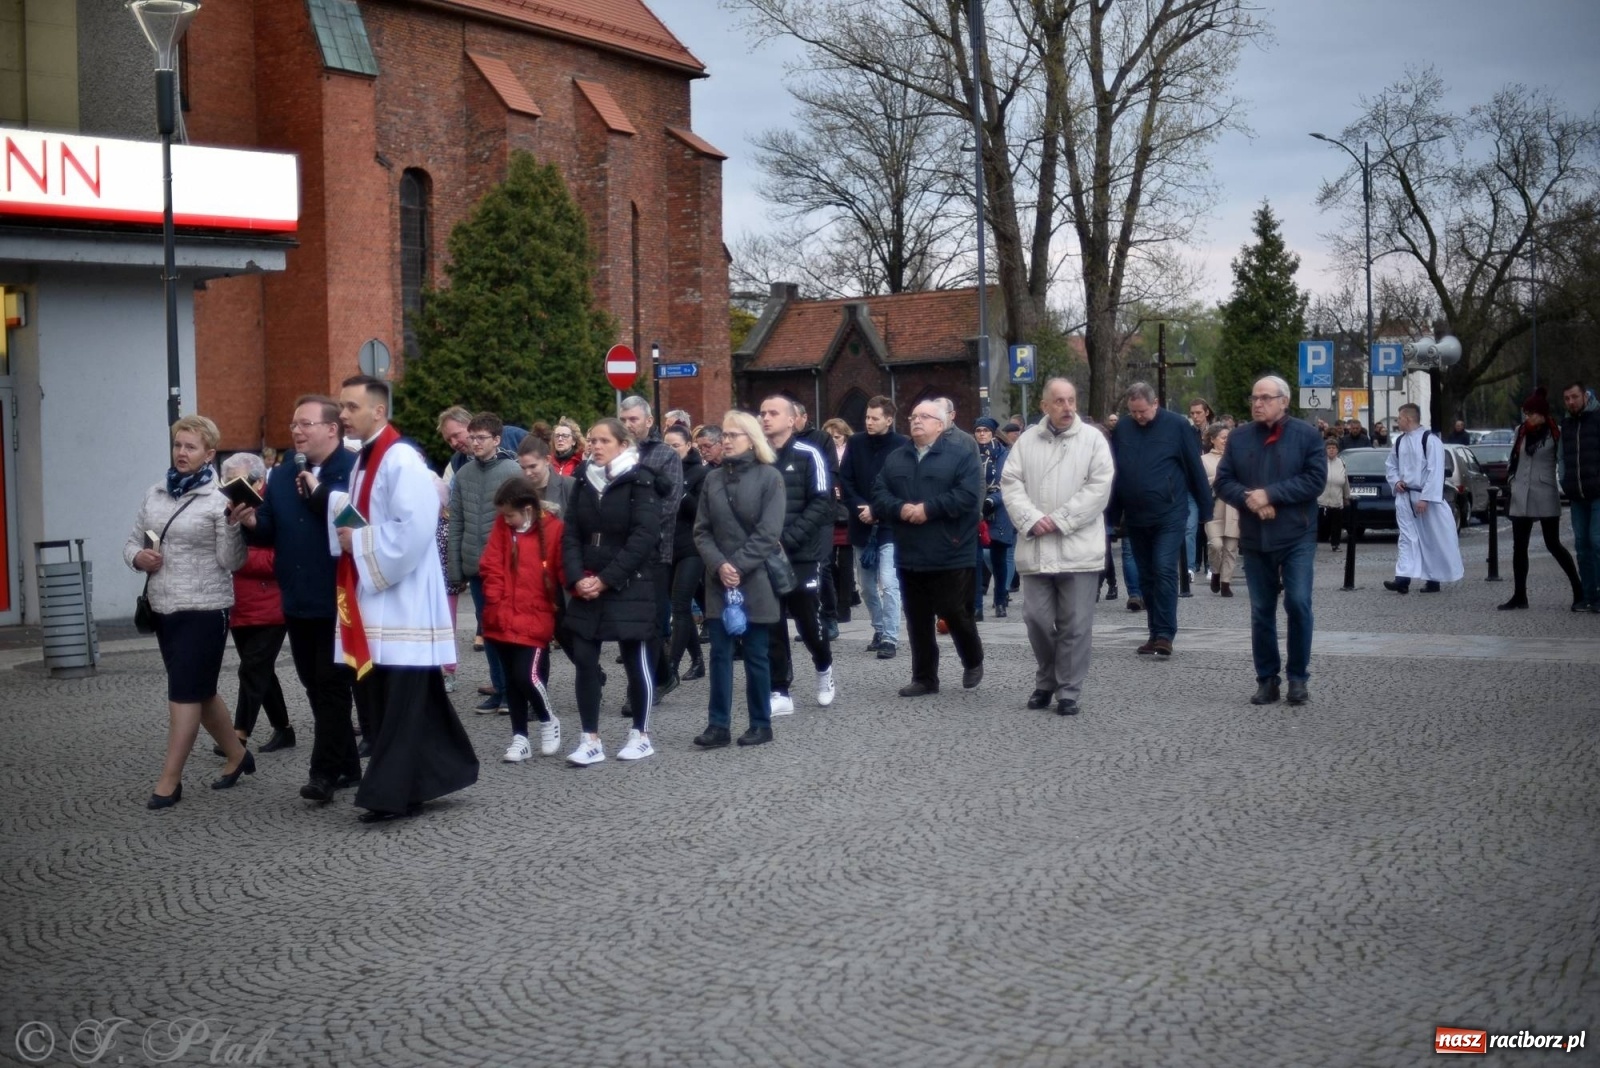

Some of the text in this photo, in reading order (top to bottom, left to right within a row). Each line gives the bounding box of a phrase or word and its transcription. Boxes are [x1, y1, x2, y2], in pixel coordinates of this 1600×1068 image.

[0, 136, 101, 199] NN
[1016, 347, 1029, 364] P
[1307, 345, 1327, 374] P
[1378, 347, 1397, 372] P
